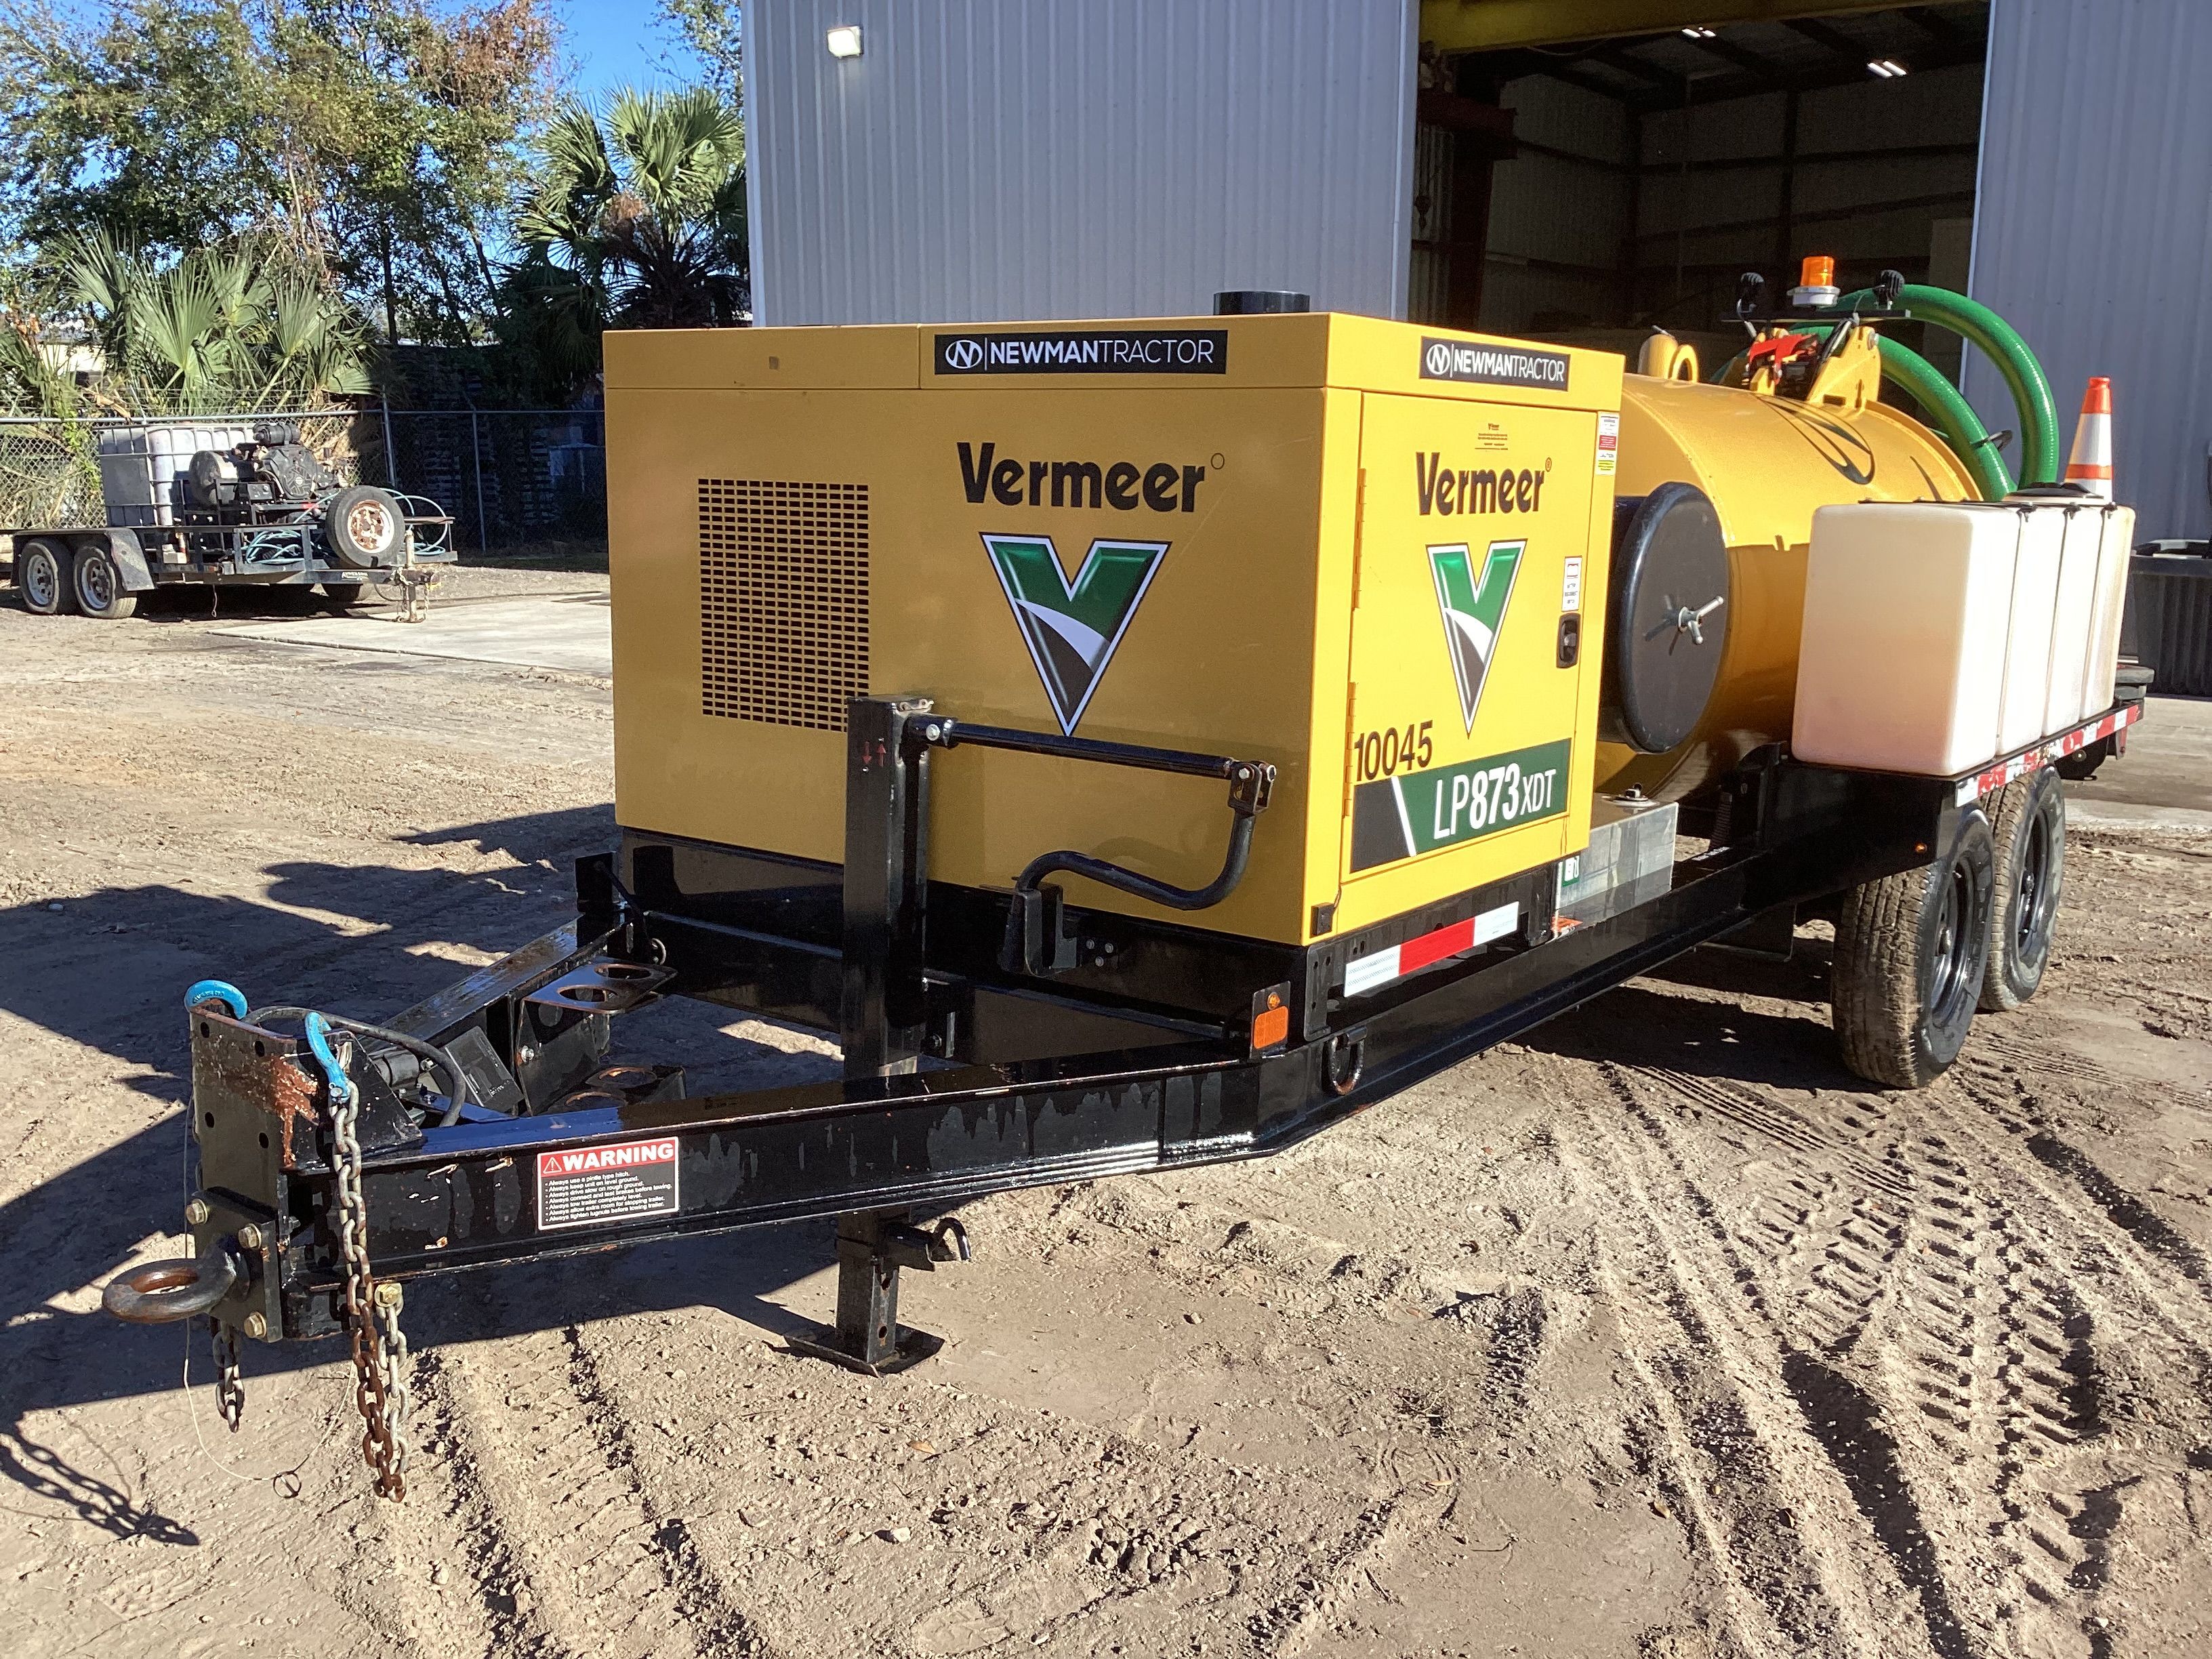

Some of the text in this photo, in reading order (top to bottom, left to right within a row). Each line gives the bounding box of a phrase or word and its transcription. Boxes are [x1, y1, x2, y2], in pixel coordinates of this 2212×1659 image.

[990, 340, 1214, 365] NEWMANTRACTOR
[1454, 348, 1565, 382] NEWMANTRACTOR
[956, 442, 1205, 513] Vermeer
[1416, 451, 1544, 516] Vermeer
[1354, 720, 1433, 781] 10045
[562, 1143, 674, 1172] WARNING
[618, 1175, 639, 1185] ground.
[623, 1181, 644, 1191] ground.
[598, 1195, 628, 1203] completely
